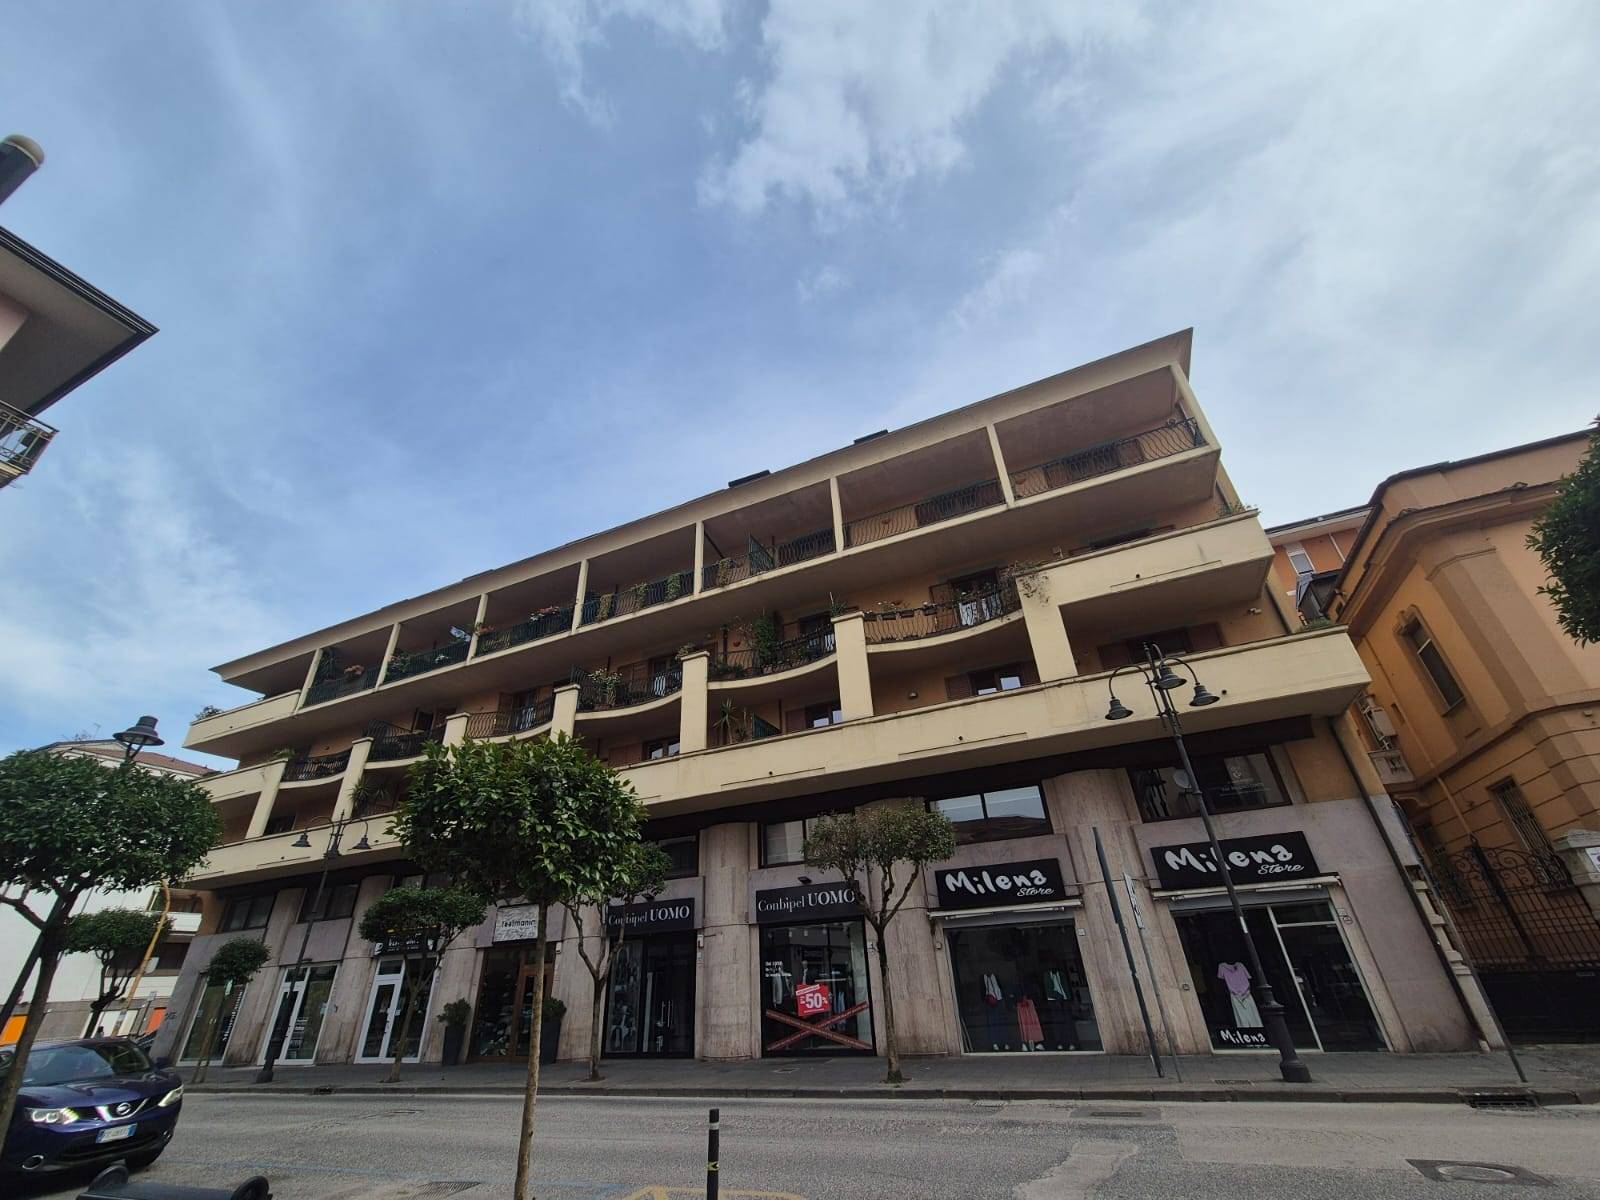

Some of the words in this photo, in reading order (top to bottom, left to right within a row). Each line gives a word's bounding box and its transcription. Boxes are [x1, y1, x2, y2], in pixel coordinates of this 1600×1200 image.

[945, 869, 1047, 894] Milena
[758, 895, 805, 912] Conbipel
[807, 889, 854, 906] UOMO
[650, 906, 690, 921] UOMO
[1220, 1029, 1266, 1044] Milena
